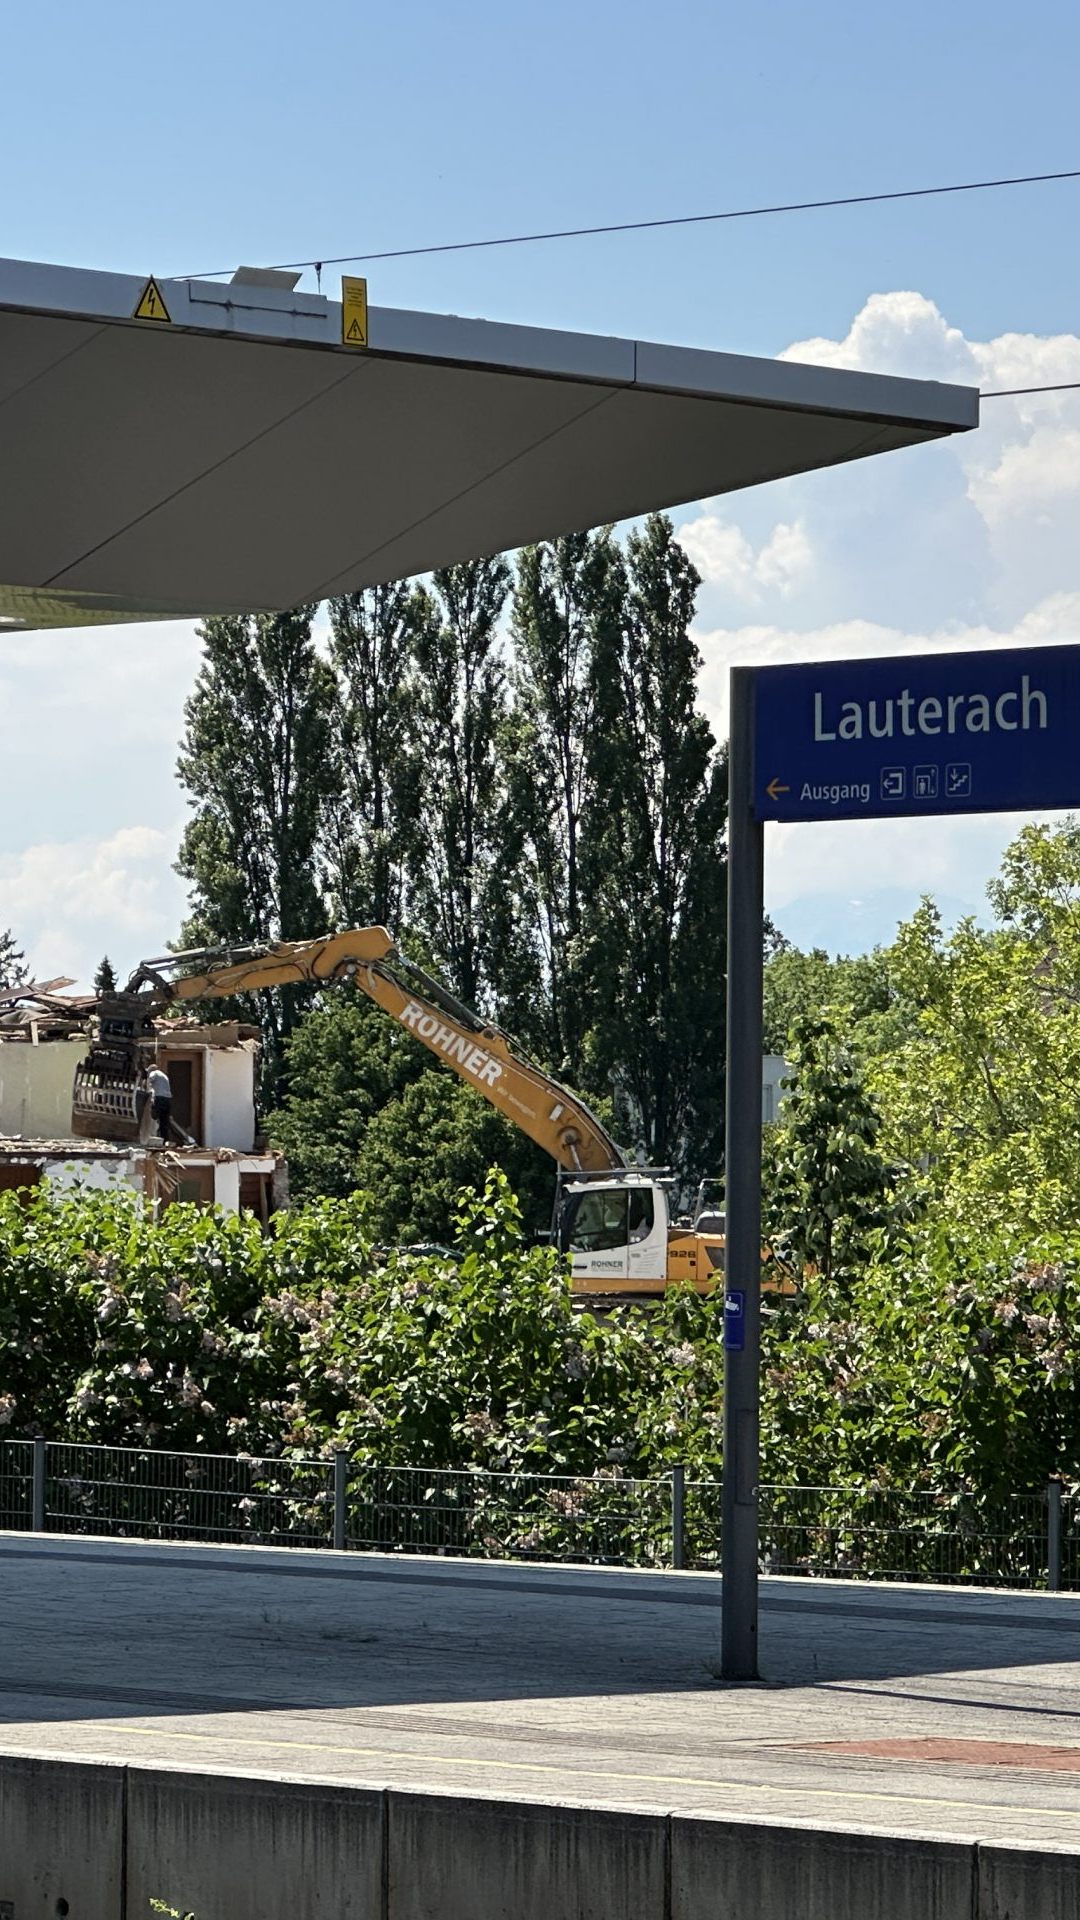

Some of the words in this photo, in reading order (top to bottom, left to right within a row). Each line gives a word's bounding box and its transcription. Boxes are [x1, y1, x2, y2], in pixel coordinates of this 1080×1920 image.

[814, 675, 1048, 741] Lauterach
[800, 782, 870, 804] Ausgang
[399, 1000, 503, 1087] ROHNER
[591, 1260, 623, 1268] ROHNER
